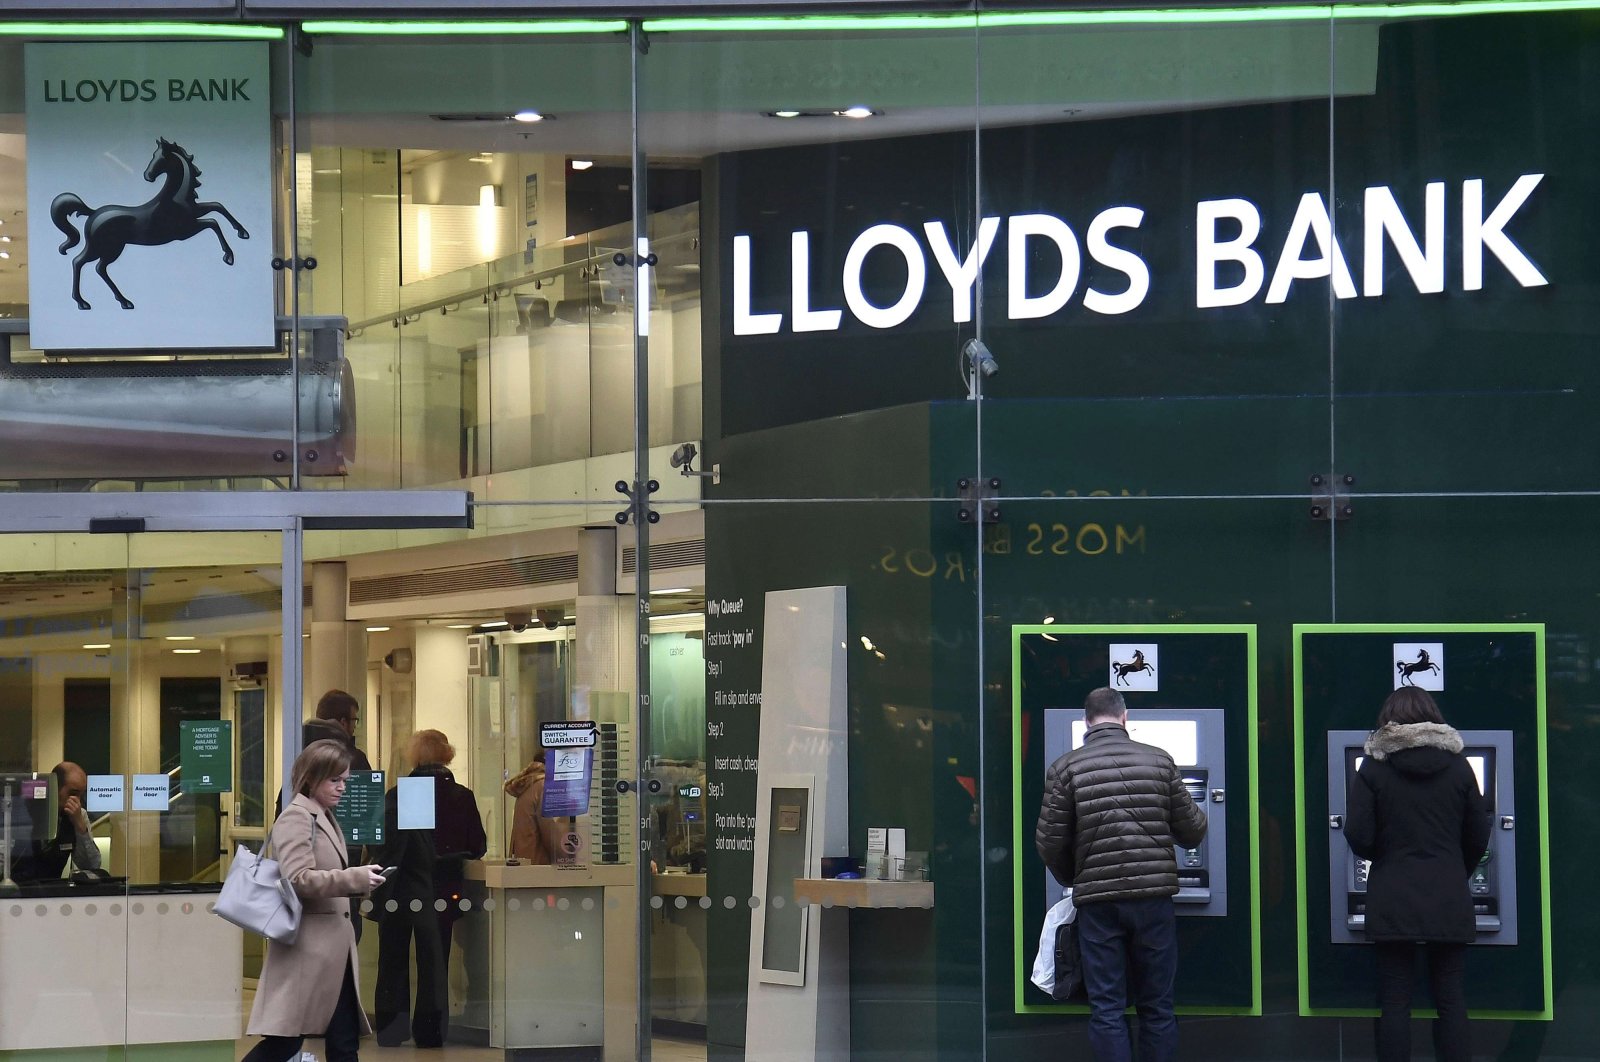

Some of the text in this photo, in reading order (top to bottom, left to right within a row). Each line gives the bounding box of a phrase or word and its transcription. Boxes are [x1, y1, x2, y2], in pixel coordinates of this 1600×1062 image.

[44, 78, 250, 102] LLOYDS BANK
[734, 174, 1548, 335] LLOYDS BANK
[708, 598, 743, 618] Why Queue?
[708, 632, 718, 646] Fast
[719, 630, 731, 645] track
[708, 661, 719, 678] Step
[722, 691, 727, 705] in
[728, 689, 737, 708] slip
[738, 689, 748, 705] and
[708, 722, 724, 739] Step 2
[715, 755, 729, 770] Insert
[730, 755, 743, 772] cash,
[708, 782, 724, 800] Step 3
[715, 812, 726, 831] Pop
[726, 812, 736, 827] into
[737, 812, 745, 828] the
[715, 834, 753, 850] slot and watch
